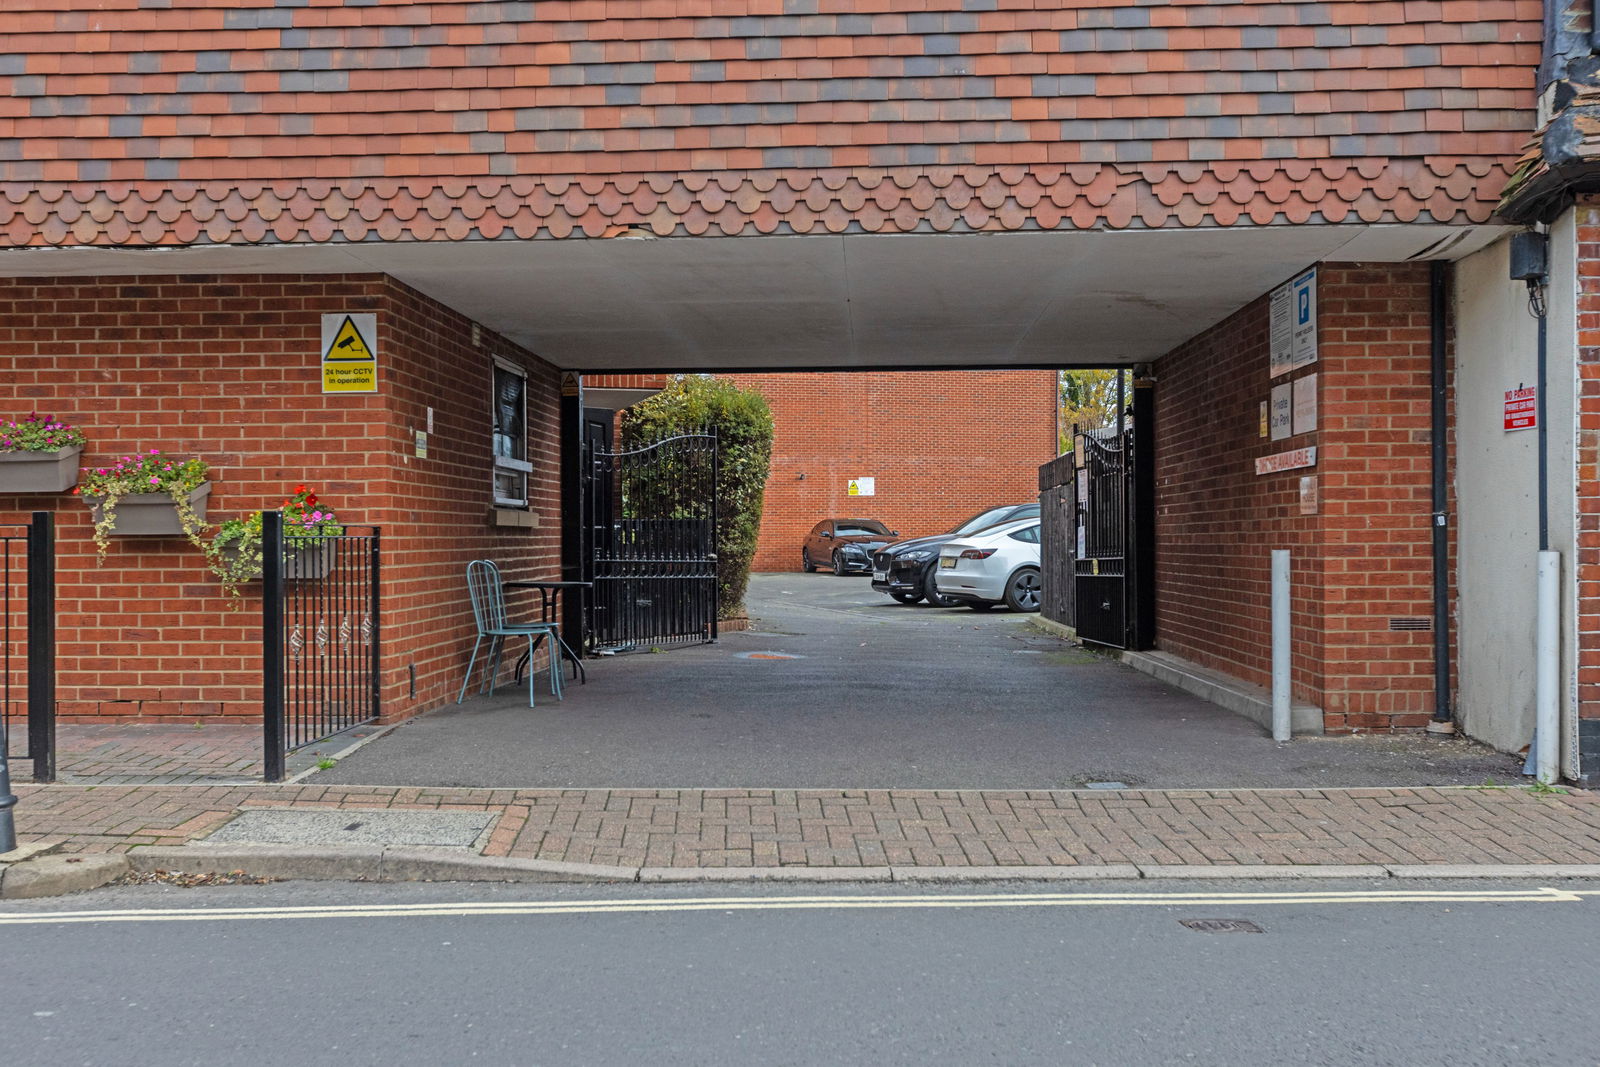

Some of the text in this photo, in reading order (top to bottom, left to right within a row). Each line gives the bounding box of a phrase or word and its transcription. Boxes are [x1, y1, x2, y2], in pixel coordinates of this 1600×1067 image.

[1505, 387, 1535, 400] NO PARKING
[1278, 449, 1310, 469] AVAILABLE
